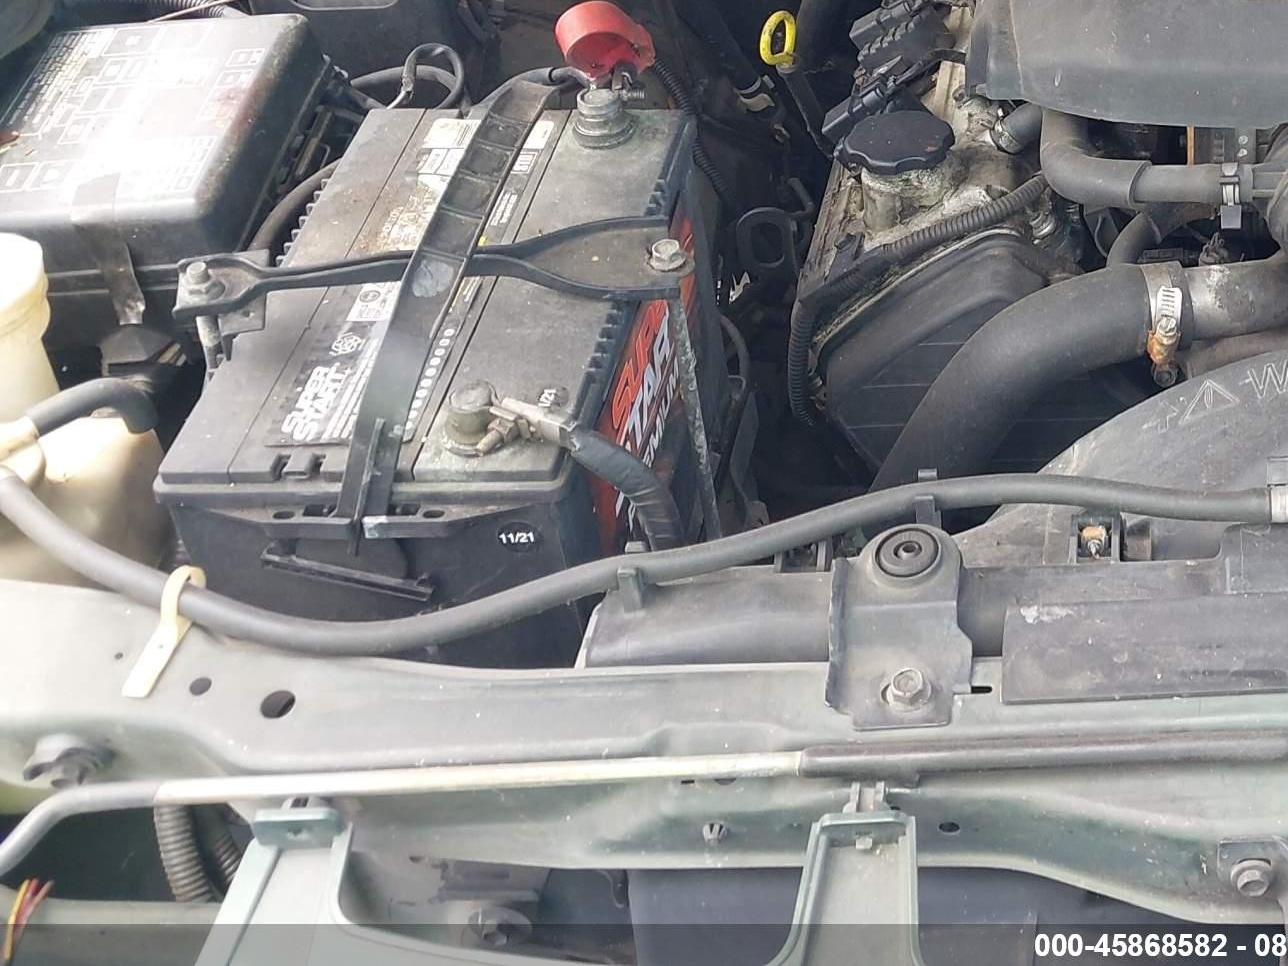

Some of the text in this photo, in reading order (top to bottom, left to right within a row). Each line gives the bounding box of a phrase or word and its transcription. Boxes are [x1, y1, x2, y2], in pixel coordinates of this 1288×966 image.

[281, 365, 333, 433] SUPER
[292, 361, 346, 442] START
[498, 532, 535, 544] 11/21
